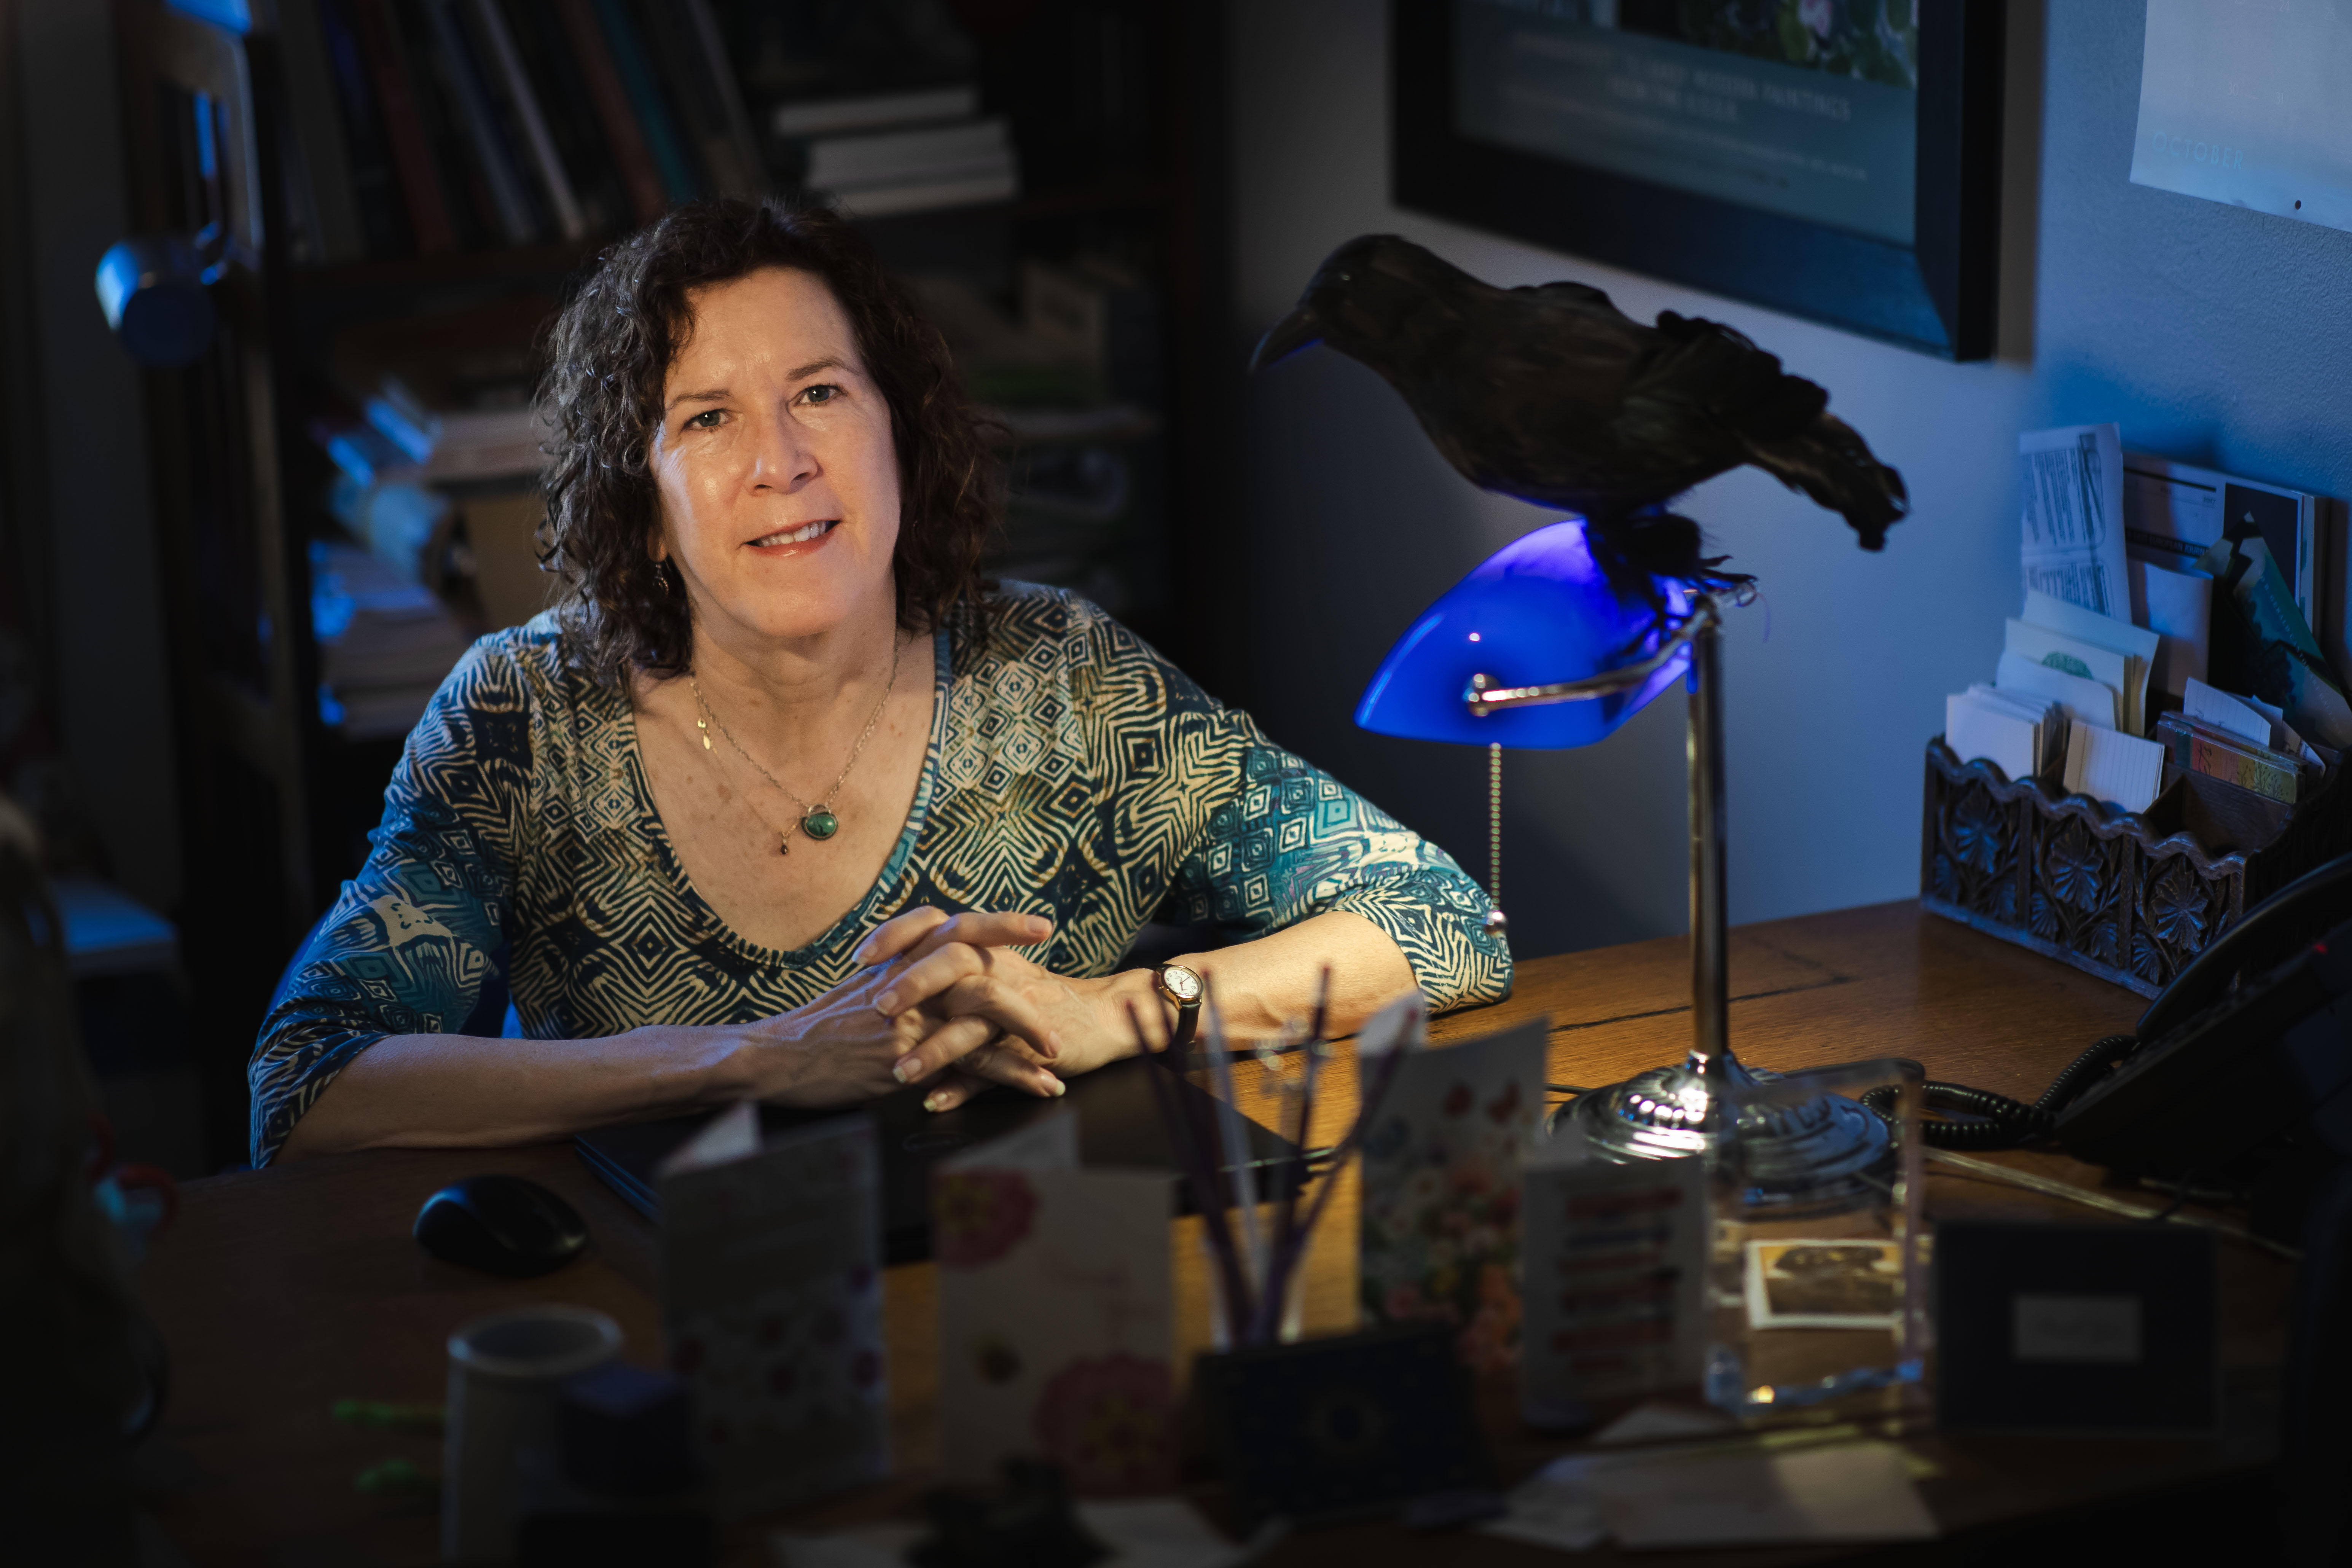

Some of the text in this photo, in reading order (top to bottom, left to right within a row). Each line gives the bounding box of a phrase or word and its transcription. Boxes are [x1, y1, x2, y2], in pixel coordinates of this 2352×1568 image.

[2227, 82, 2238, 96] 30
[2276, 92, 2284, 105] 31
[2152, 131, 2244, 170] OCTOBER
[2185, 543, 2208, 557] JOURN
[2268, 594, 2291, 633] GERALD
